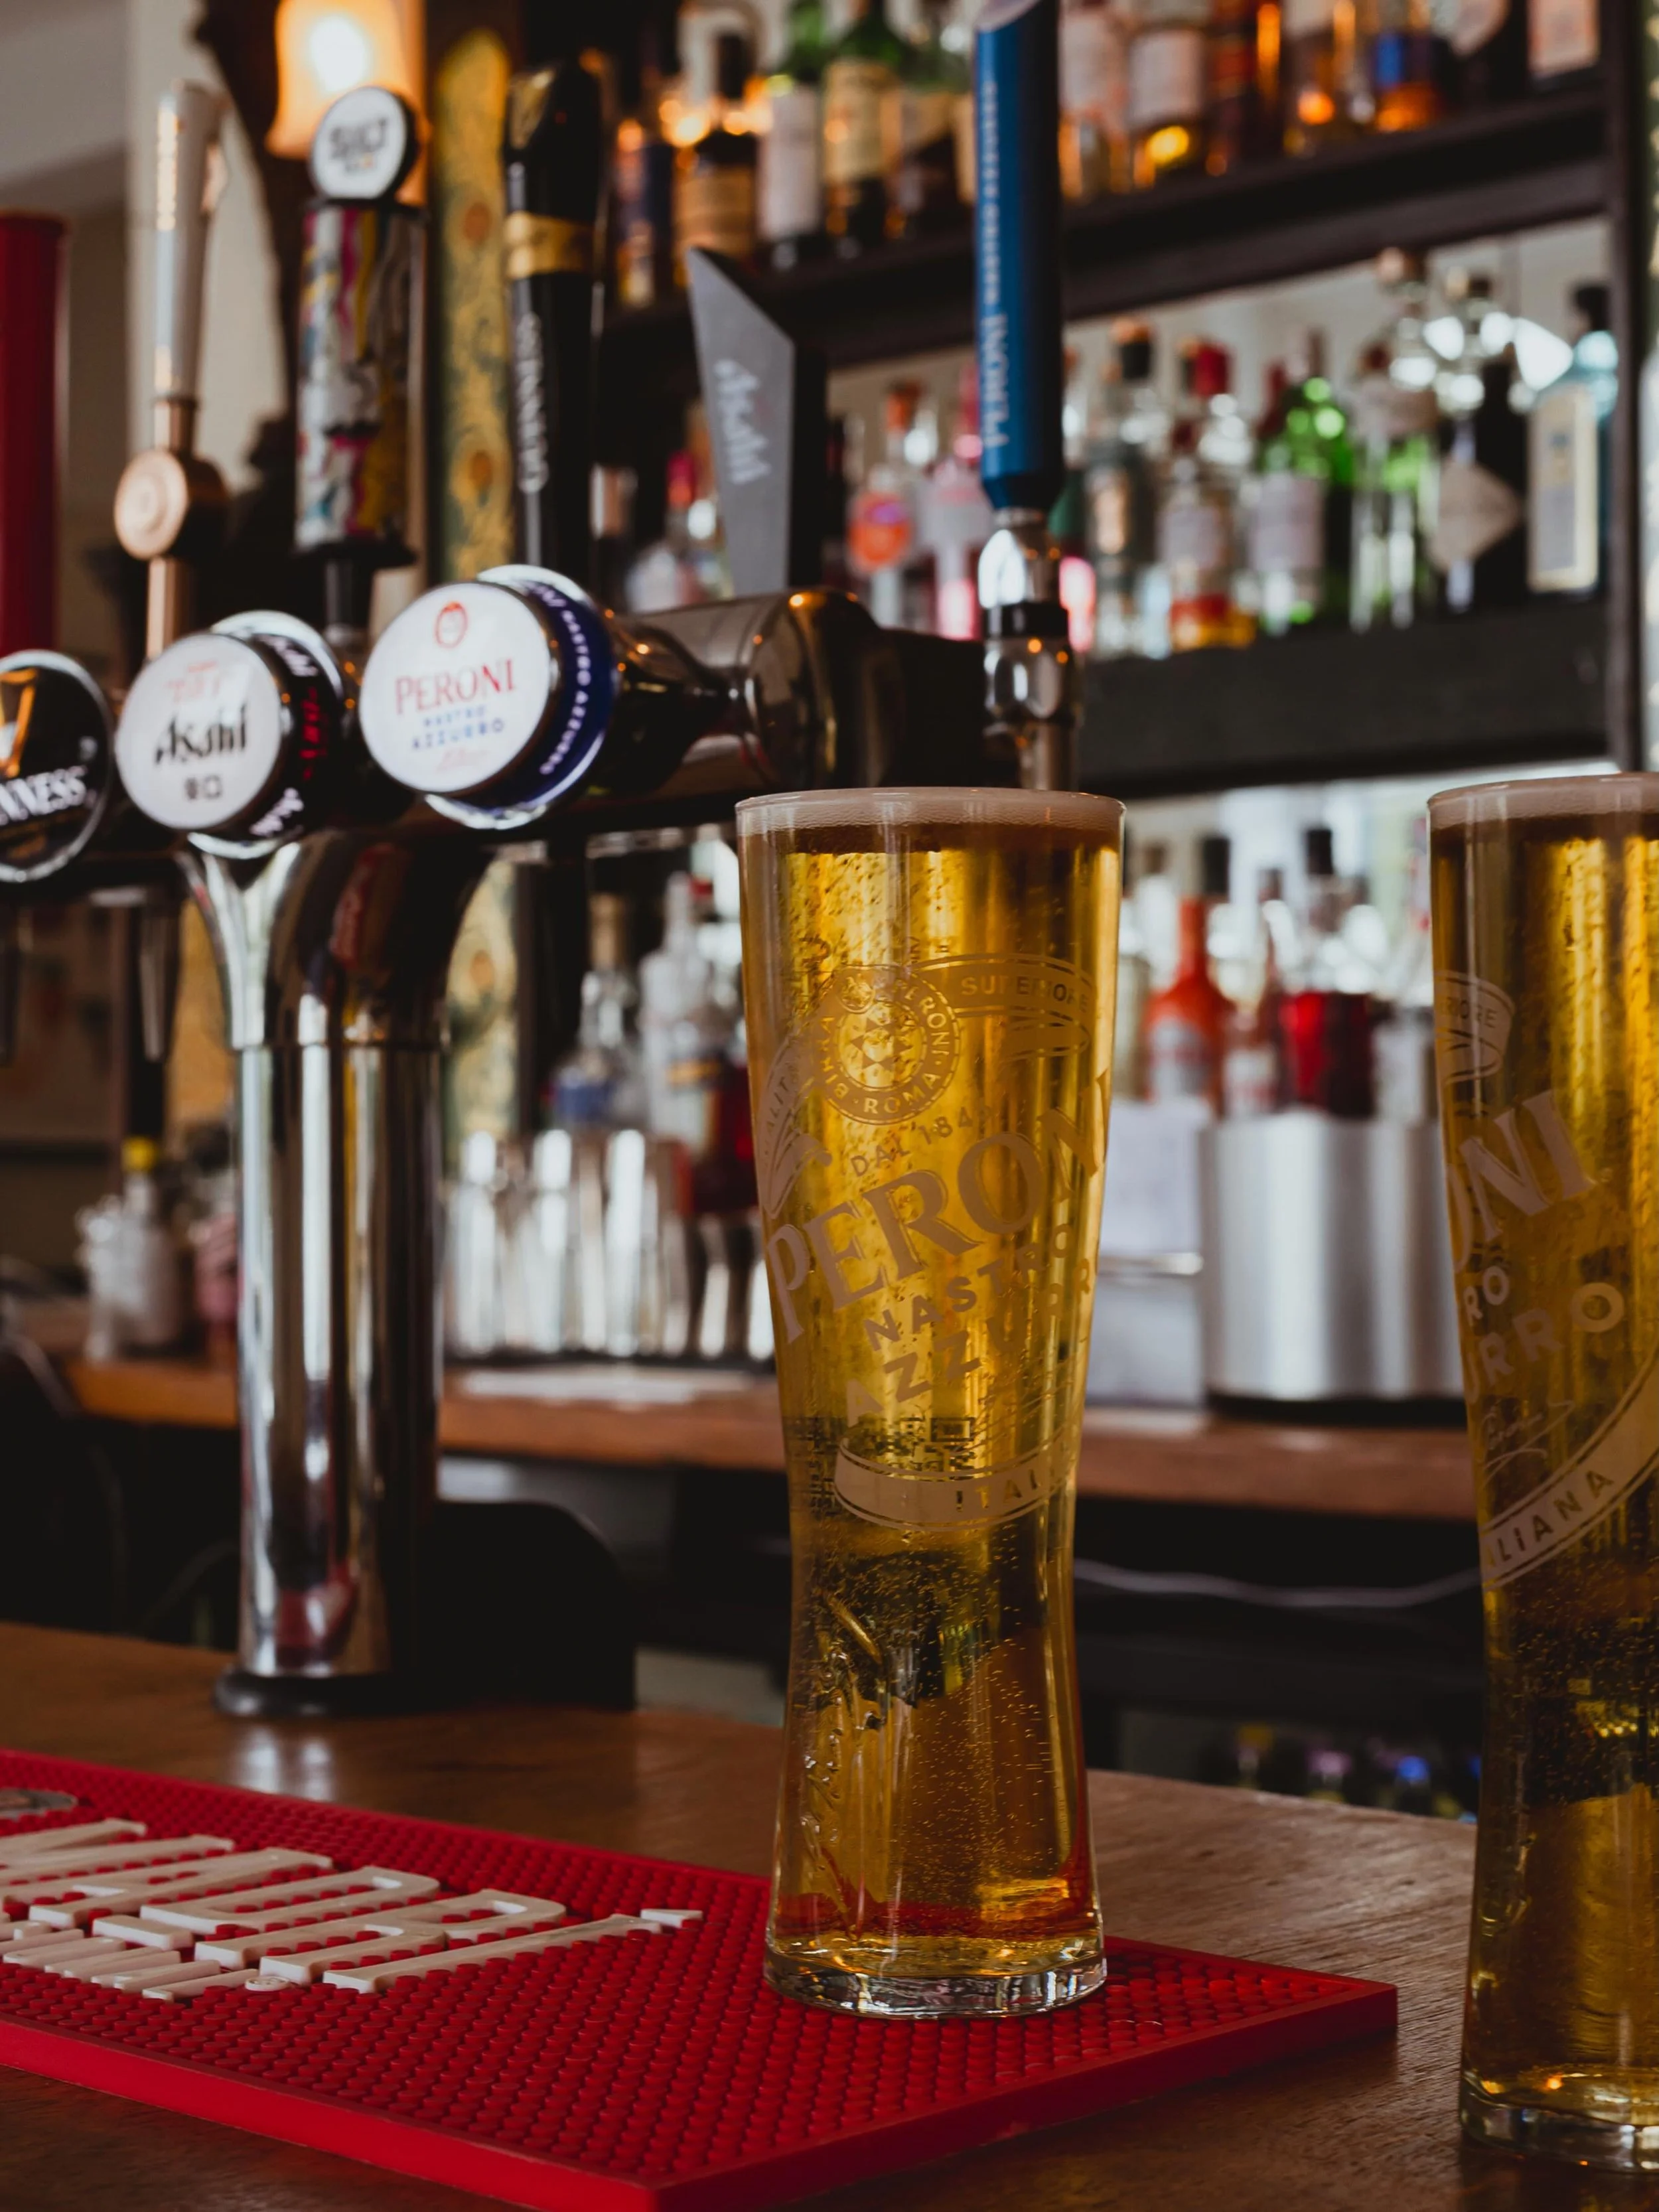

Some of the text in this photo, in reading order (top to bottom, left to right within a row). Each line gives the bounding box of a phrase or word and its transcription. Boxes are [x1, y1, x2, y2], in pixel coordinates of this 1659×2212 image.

[394, 659, 516, 716] PERONI
[863, 1072, 942, 1115] ROMA
[863, 1223, 1072, 1352] NASTRO
